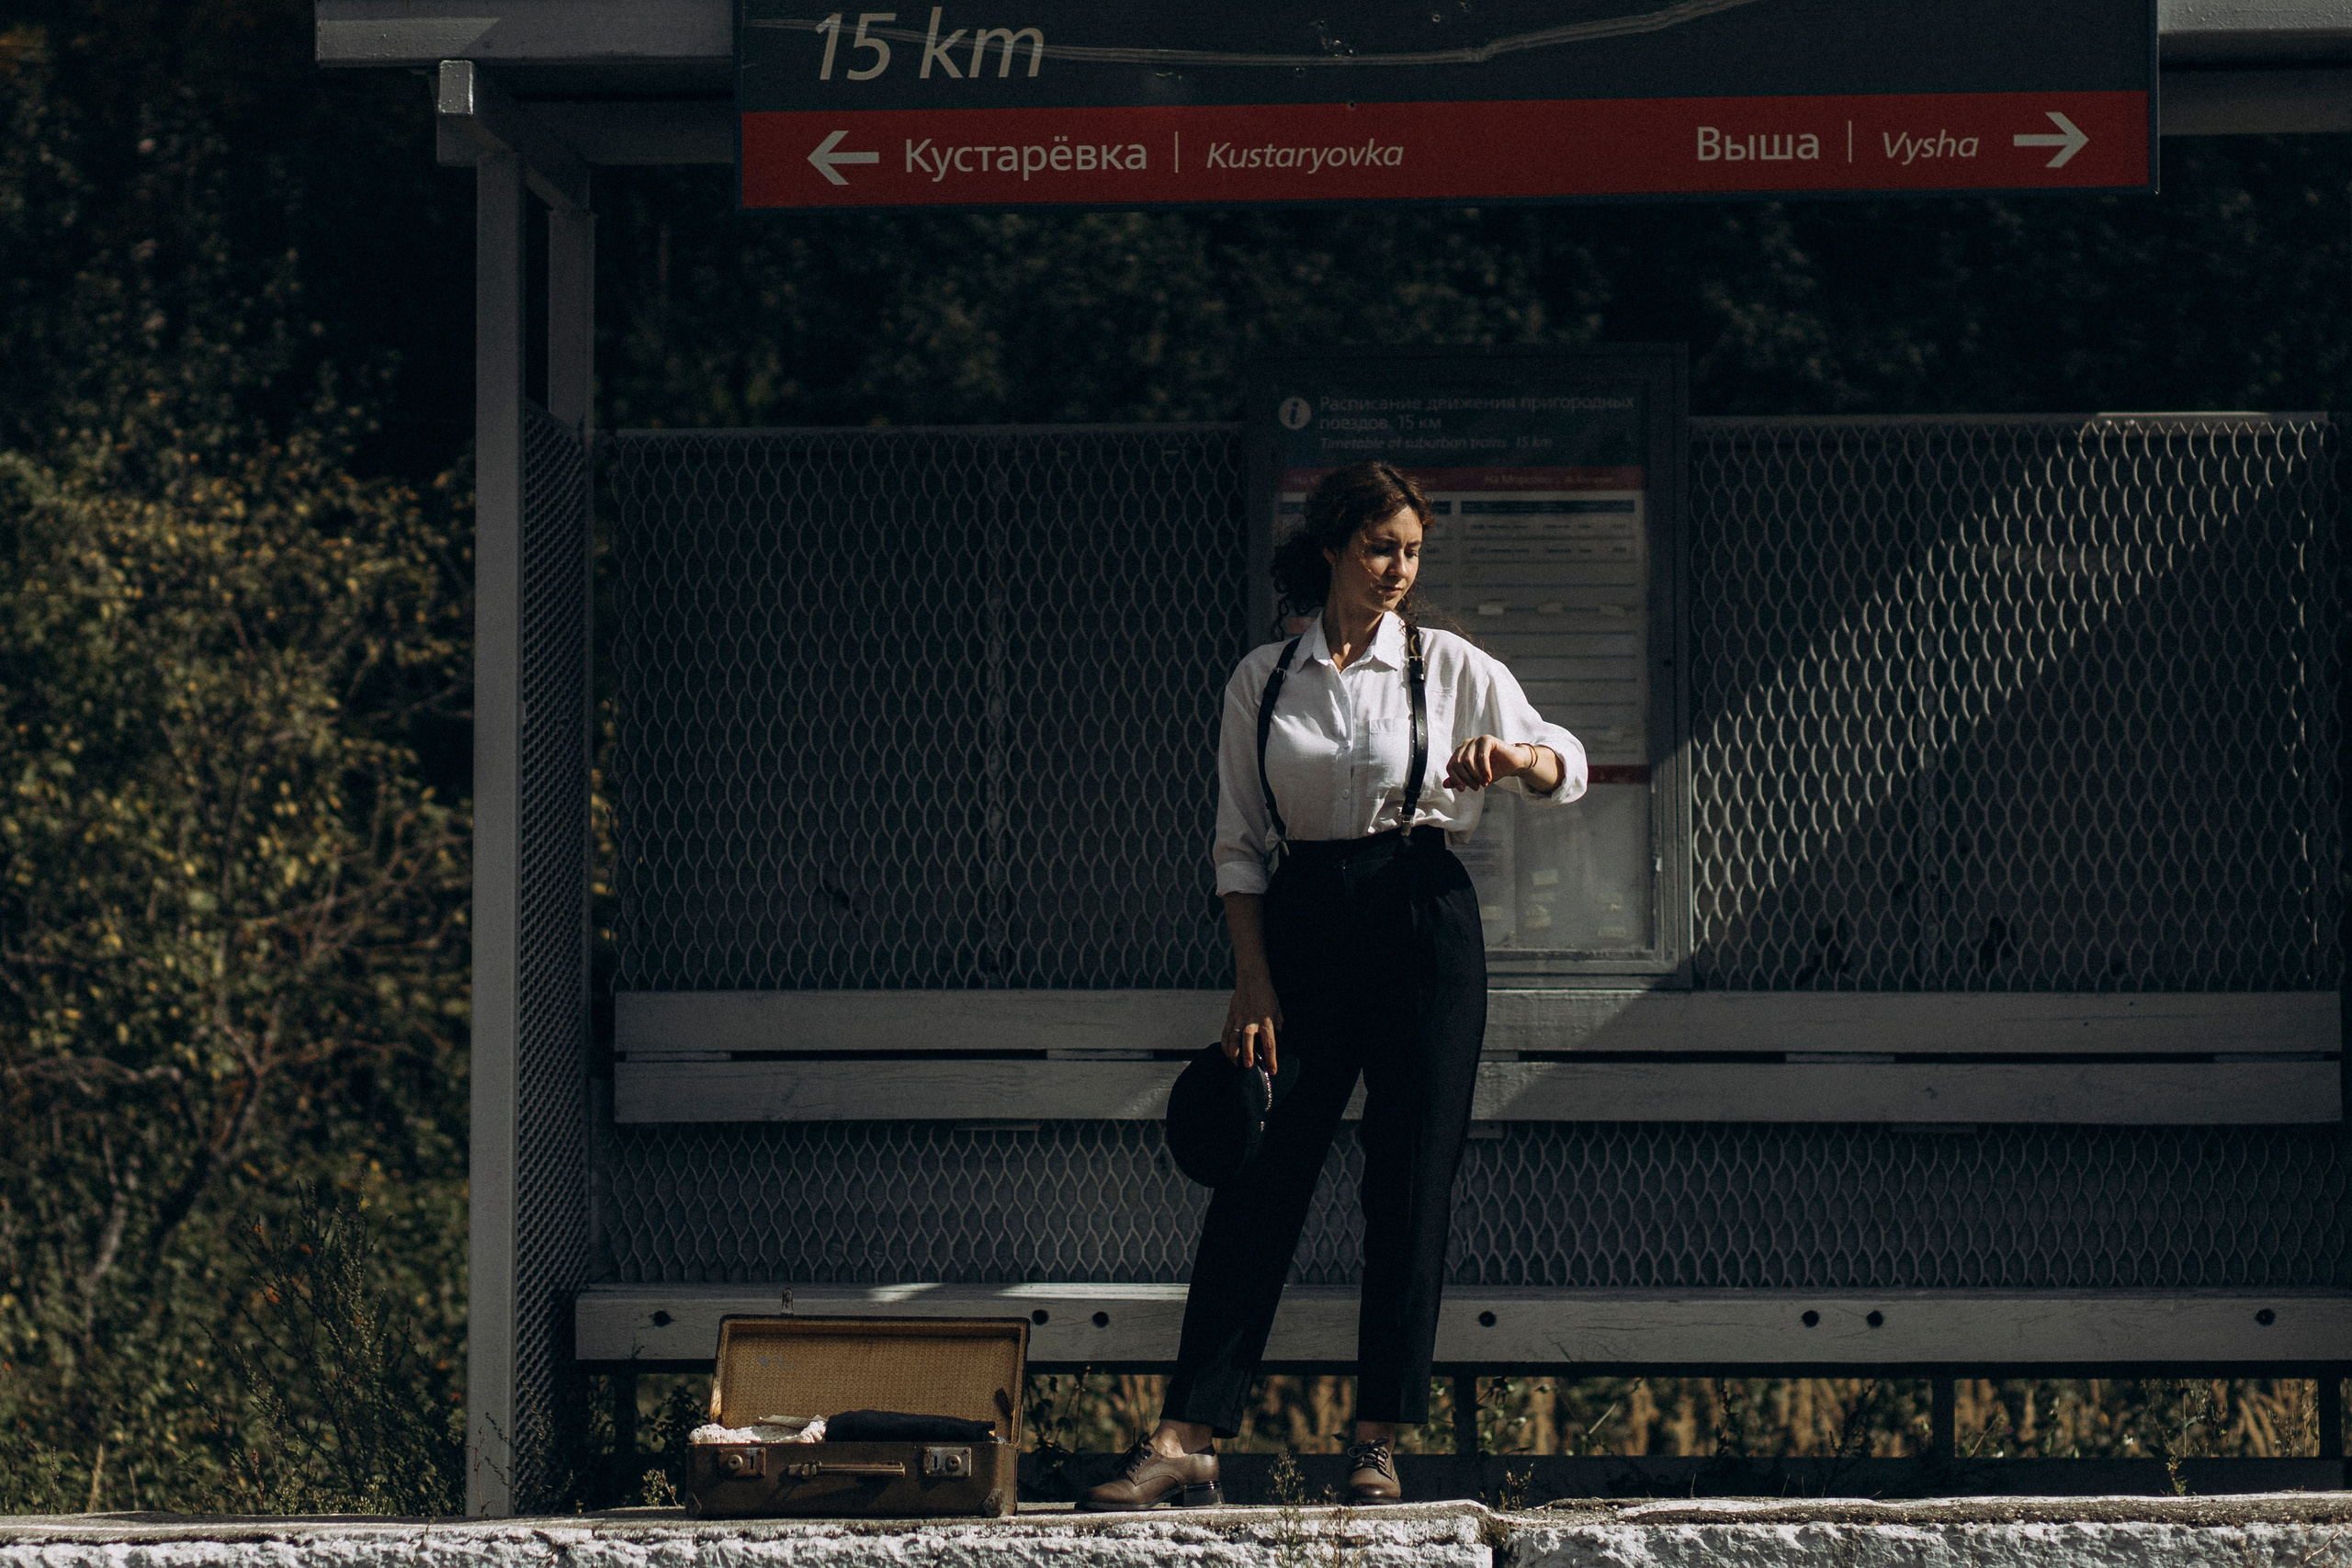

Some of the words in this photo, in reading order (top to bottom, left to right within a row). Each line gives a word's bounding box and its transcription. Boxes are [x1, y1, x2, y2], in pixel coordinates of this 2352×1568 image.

[815, 12, 897, 81] 15
[919, 6, 1045, 79] km
[905, 135, 1148, 183] Кустарёвка
[1205, 138, 1405, 175] Kustaryovka
[1696, 126, 1820, 162] Выша
[1882, 129, 1980, 166] Vysha
[1319, 396, 1422, 412] Расписание
[1425, 398, 1516, 412] движения
[1521, 397, 1634, 412] пригородных
[1397, 413, 1415, 430] 15
[1419, 417, 1442, 430] км
[1320, 435, 1385, 449] Timetable
[1388, 434, 1403, 449] of
[1405, 435, 1467, 449] suburban
